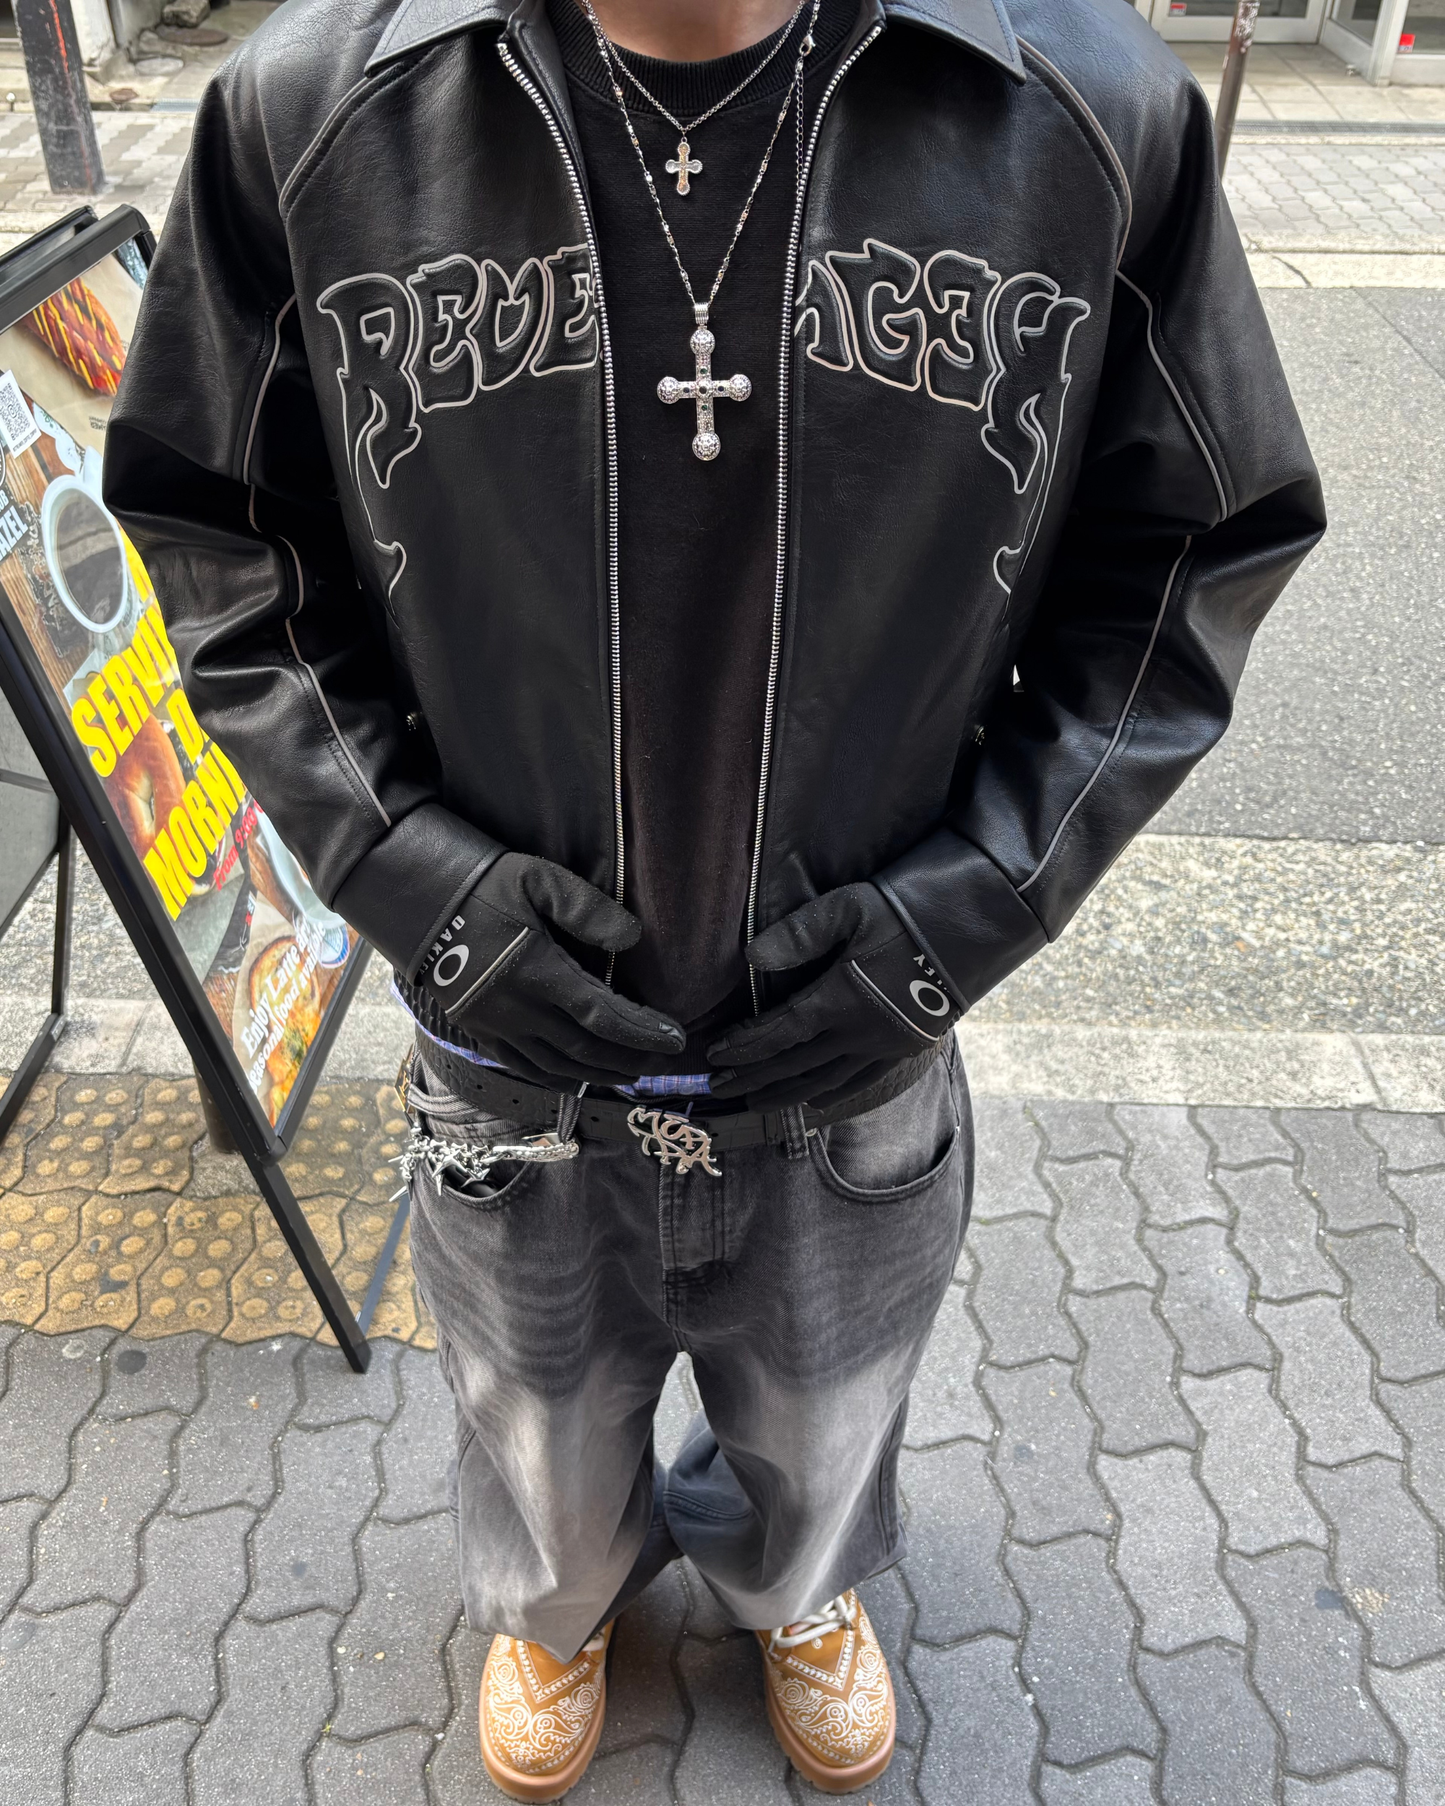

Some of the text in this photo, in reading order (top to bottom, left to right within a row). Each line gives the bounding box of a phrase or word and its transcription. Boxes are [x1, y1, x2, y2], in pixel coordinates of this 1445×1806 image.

[213, 806, 258, 891] From 9:00
[240, 993, 277, 1059] Enjoy
[265, 944, 301, 998] Latte
[274, 978, 300, 1024] food
